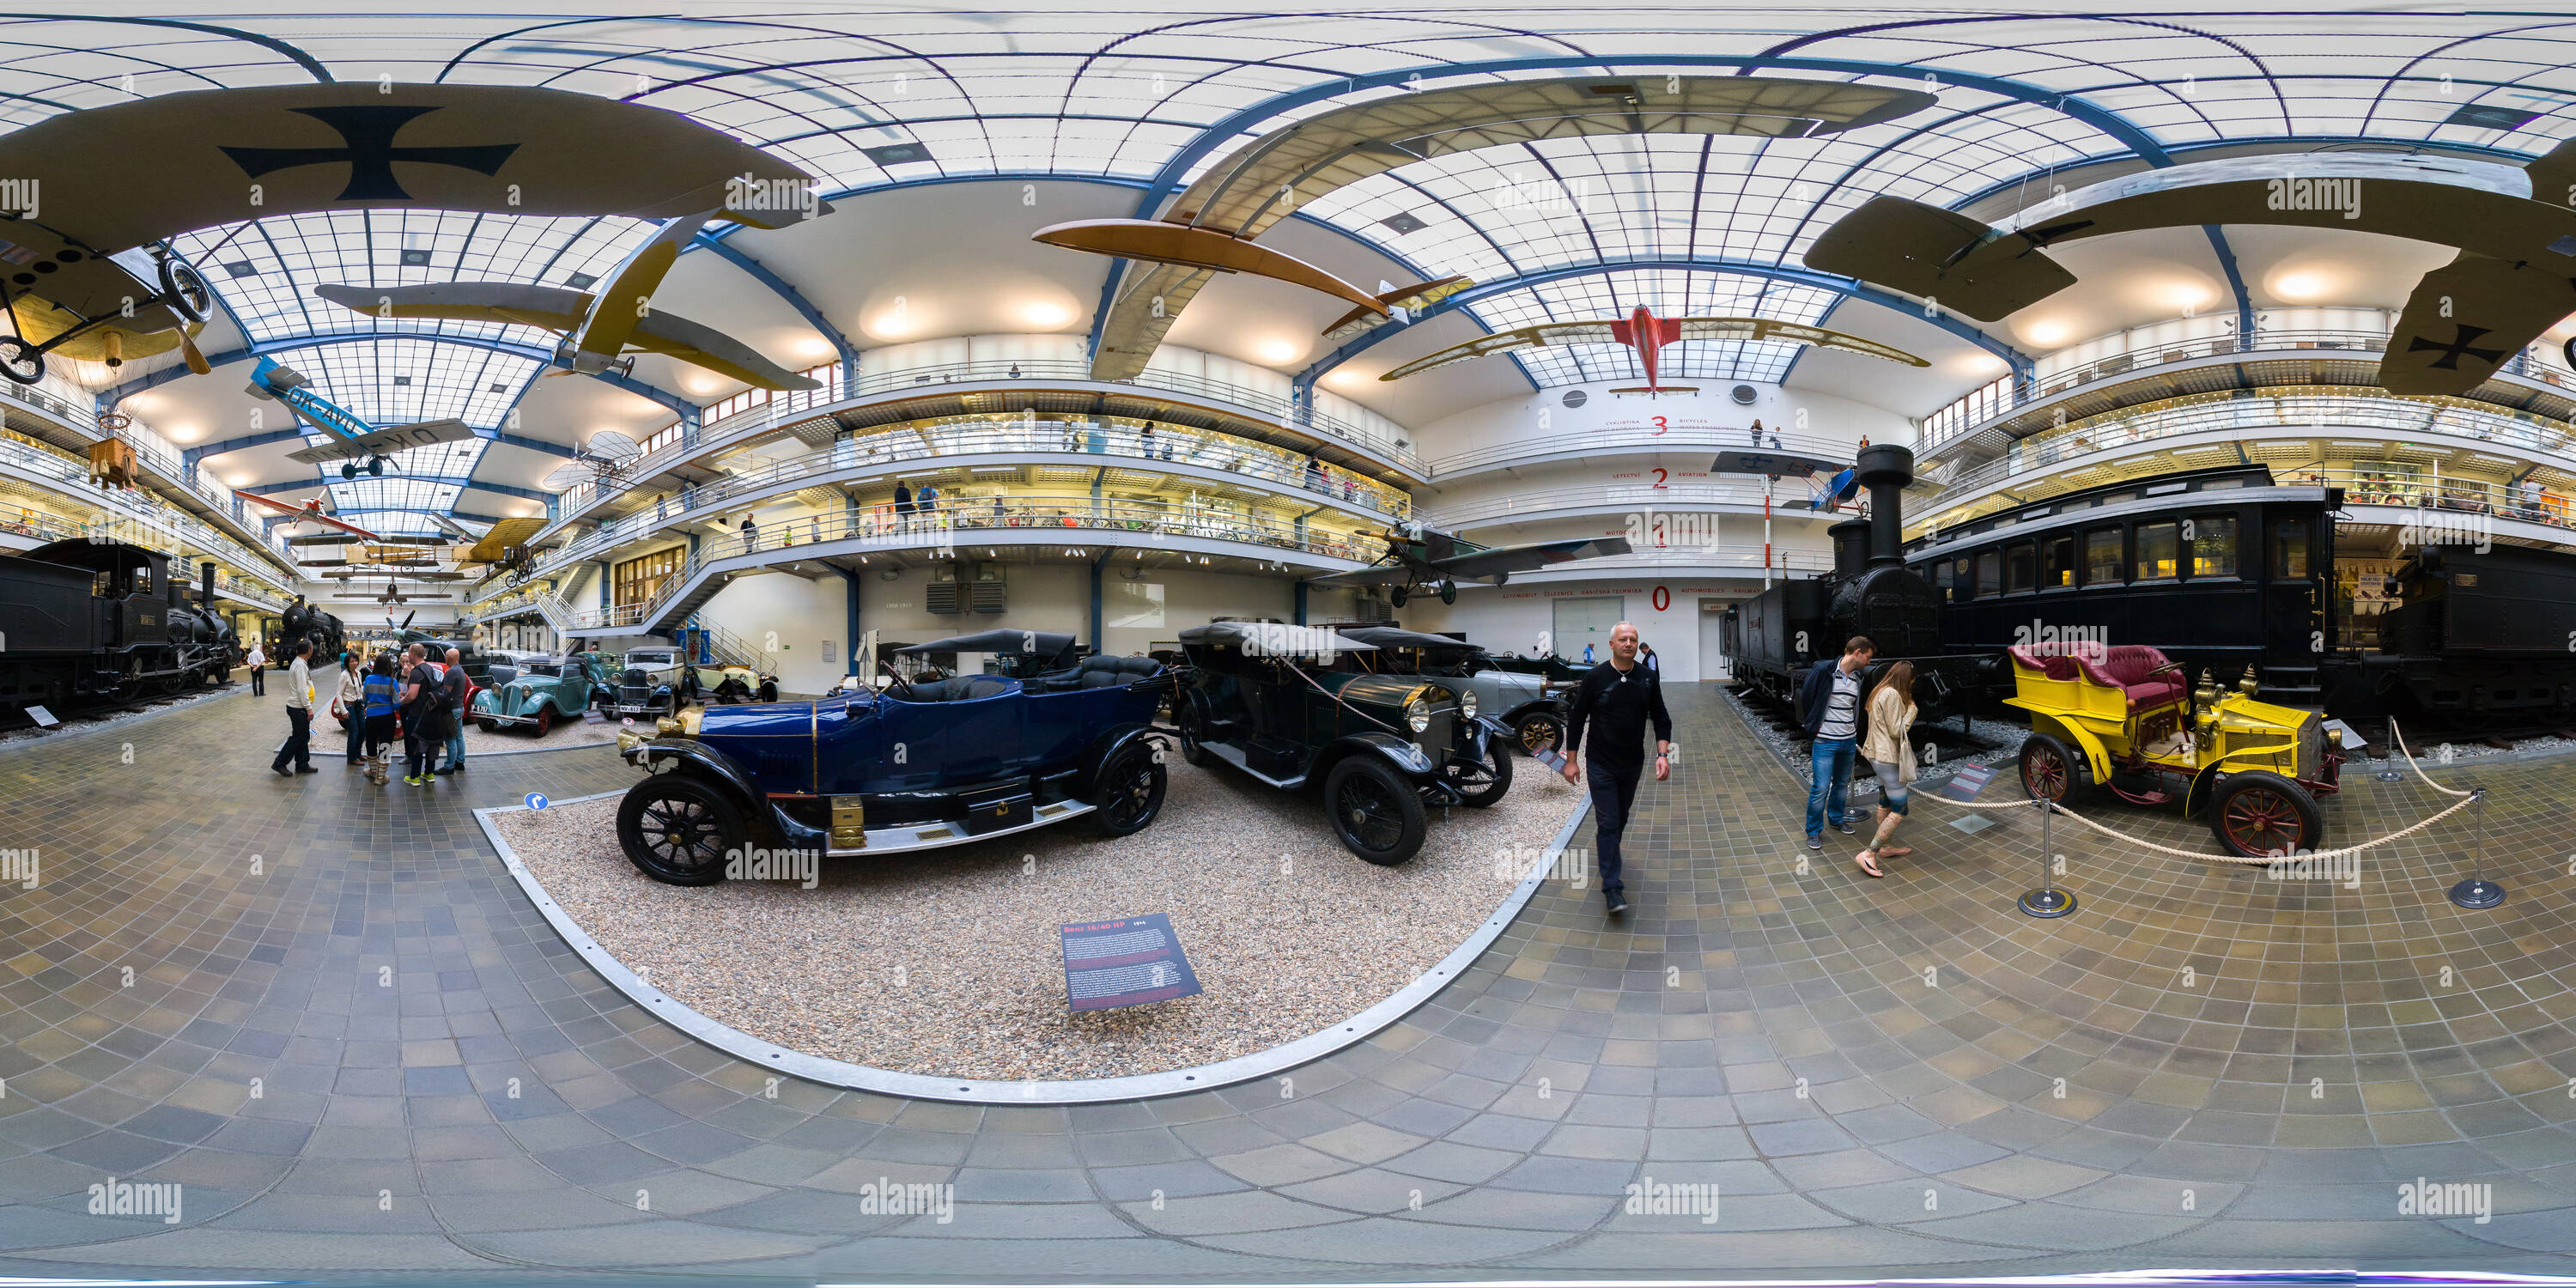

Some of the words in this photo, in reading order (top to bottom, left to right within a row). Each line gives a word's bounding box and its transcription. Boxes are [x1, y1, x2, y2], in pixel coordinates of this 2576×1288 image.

[288, 388, 357, 434] OK-AVO
[1651, 416, 1668, 436] 3
[1651, 468, 1668, 489] 2
[1652, 525, 1668, 548] 1
[1652, 586, 1670, 611] 0
[388, 606, 393, 615] 1
[1087, 923, 1111, 932] 16/40
